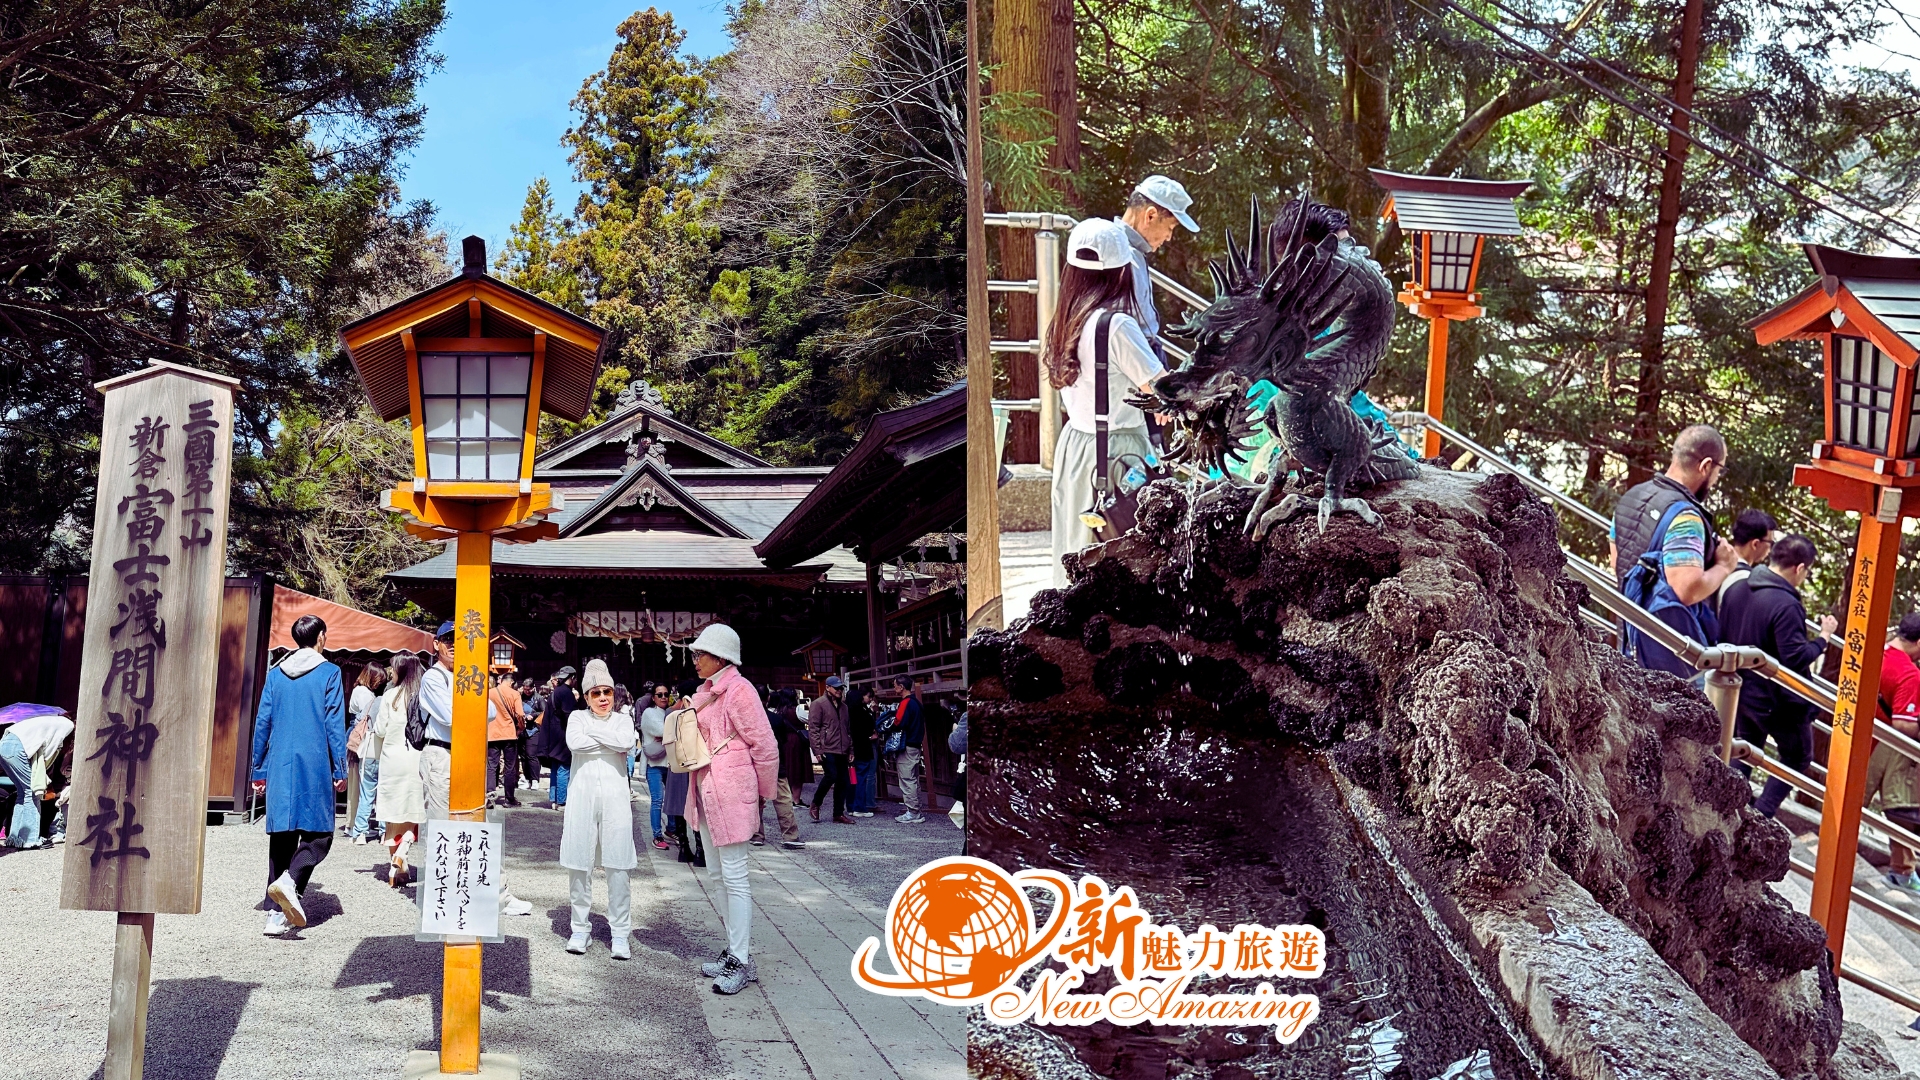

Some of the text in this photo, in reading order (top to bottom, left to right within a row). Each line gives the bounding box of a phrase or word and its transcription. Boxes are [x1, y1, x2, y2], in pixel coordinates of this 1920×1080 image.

[180, 398, 221, 549] 三國第一山
[1853, 557, 1873, 617] 有限会社
[456, 608, 487, 697] 奉納
[435, 832, 449, 920] 入れないで下さい
[477, 830, 490, 886] これより先
